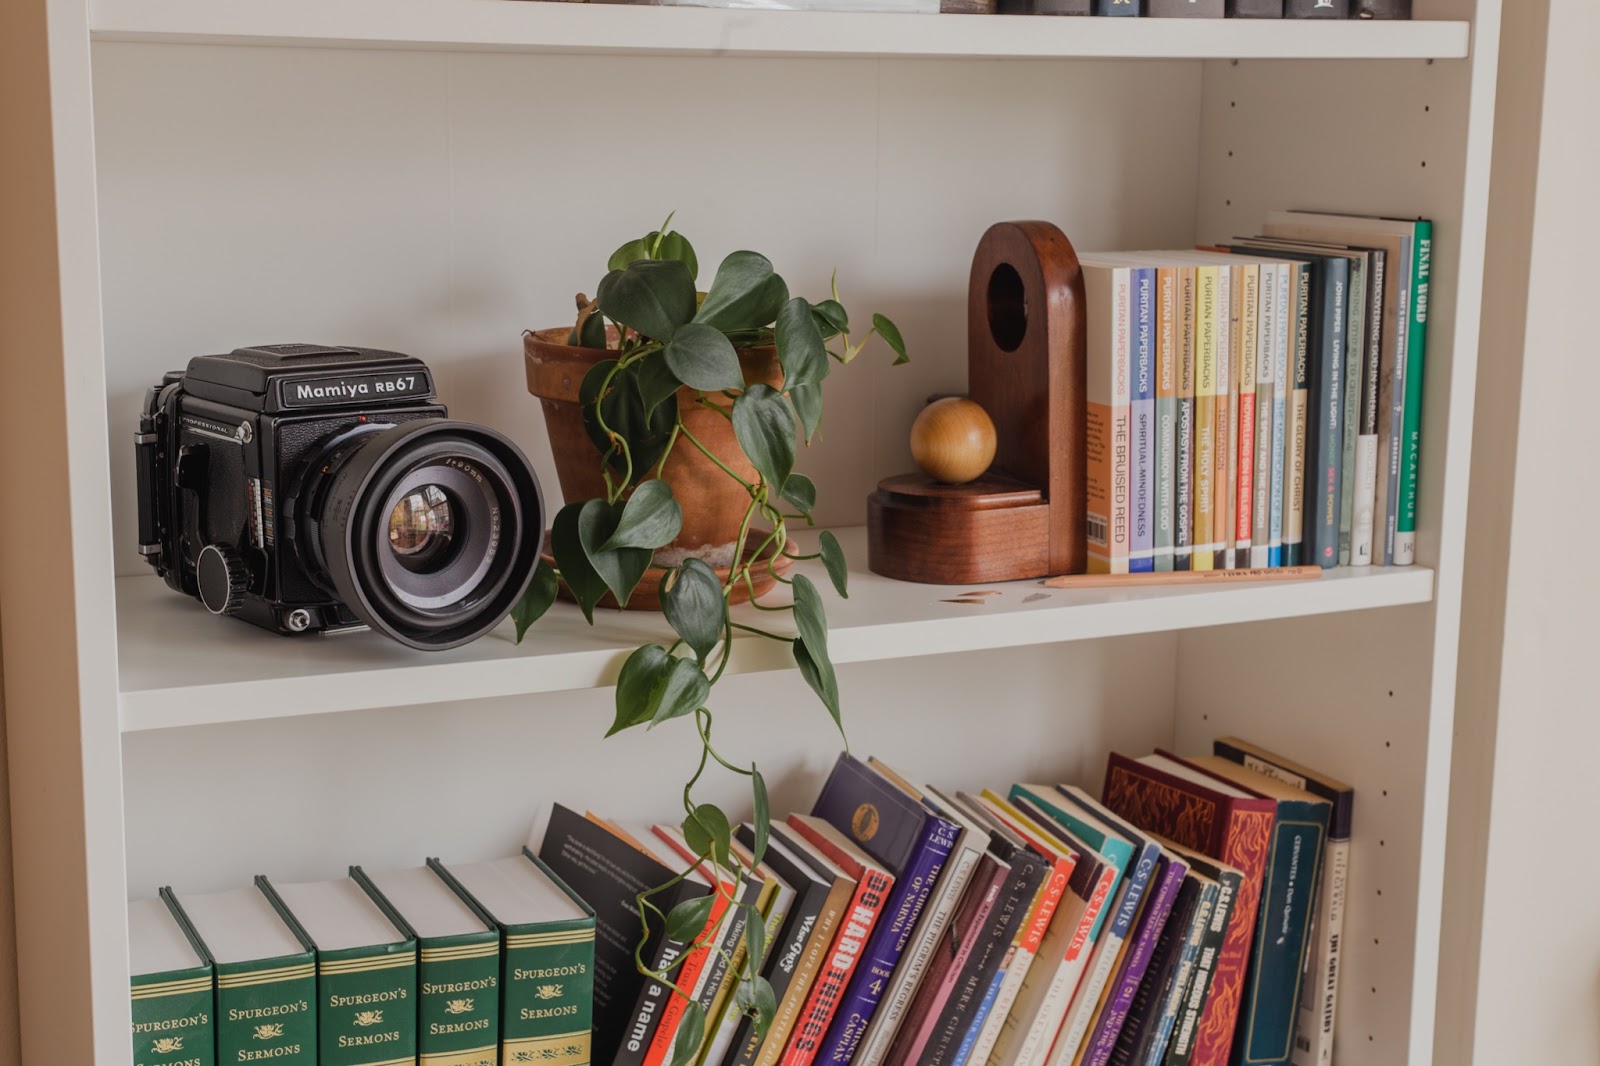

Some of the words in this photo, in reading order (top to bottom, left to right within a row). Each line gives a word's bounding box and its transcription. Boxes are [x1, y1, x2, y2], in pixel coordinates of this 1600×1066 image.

[1418, 238, 1430, 279] FINAL
[1139, 279, 1148, 322] PURITAN
[1184, 278, 1192, 320] PURITAN
[1246, 275, 1254, 316] PURITAN
[1300, 272, 1308, 315] PURITAN
[1372, 261, 1383, 340] REDISCOVERING
[1415, 282, 1428, 323] WORD
[1138, 325, 1147, 392] PAPERBACKS
[1162, 323, 1170, 389] PAPERBACKS
[1182, 324, 1190, 390] PAPERBACKS
[1202, 322, 1211, 388] PAPERBACKS
[1219, 320, 1227, 386] PAPERBACKS
[1244, 320, 1253, 385] PAPERBACKS
[1262, 315, 1271, 377] PAPERBACKS
[1297, 317, 1307, 382] PAPERBACKS
[1370, 344, 1378, 367] GOD
[1331, 370, 1338, 380] IN
[1349, 364, 1356, 375] TO
[1370, 370, 1377, 380] IN
[296, 381, 369, 399] Mamiya
[375, 376, 415, 393] RB67
[1368, 382, 1376, 427] AMERICA
[183, 417, 228, 434] PROFESSIONAL
[1116, 415, 1125, 442] THE
[1180, 401, 1189, 452] APOSTASY
[1241, 396, 1250, 454] INDWELLING
[1160, 414, 1169, 477] COMMUNION
[1273, 422, 1282, 497] MORTIFICATION
[1115, 445, 1125, 502] BRUISED
[1137, 414, 1146, 536] SPIRITUAL-MINDEDNESS
[1180, 454, 1188, 482] FROM
[1240, 475, 1248, 485] IN
[1294, 460, 1301, 473] OF
[1406, 431, 1418, 518] MACARTHUR
[1200, 479, 1208, 513] SPIRIT
[1239, 487, 1248, 537] BELIEVERS
[1256, 490, 1265, 528] CHURCH
[1114, 507, 1124, 543] REED
[1178, 505, 1187, 543] GOSPEL
[928, 833, 954, 848] LEWIS
[938, 827, 946, 836] C.
[1022, 864, 1034, 875] C.
[1288, 834, 1301, 880] CERVANTES
[912, 877, 922, 892] OF
[926, 865, 940, 884] THE
[1014, 880, 1026, 890] S.
[1164, 870, 1175, 884] THE
[860, 875, 888, 908] DO
[986, 885, 998, 902] Lewis
[1118, 884, 1142, 926] LEWIS
[1146, 885, 1168, 929] CHRONICLES
[1284, 887, 1293, 904] Don
[772, 913, 784, 932] The
[822, 910, 836, 931] WHY
[891, 893, 915, 932] NARNIA
[896, 888, 929, 951] CHRONICLES
[933, 912, 946, 929] THE
[982, 904, 988, 913] An
[993, 896, 1018, 936] LEWIS
[1029, 900, 1054, 943] LEWIS
[700, 917, 714, 938] Can
[726, 920, 745, 947] Taking
[832, 906, 874, 970] HARD
[965, 914, 984, 949] Experiment
[1070, 908, 1098, 949] LEWIS
[1329, 934, 1338, 953] THE
[735, 944, 746, 960] THE
[805, 942, 821, 969] LOVE
[910, 932, 936, 979] PILGRIM'S
[1129, 940, 1146, 968] NARNIA
[1200, 947, 1214, 969] THAT
[422, 976, 496, 994] SPURGEON'S
[514, 963, 586, 980] SPURGEON'S
[680, 962, 696, 987] Trust
[713, 969, 722, 980] At
[795, 973, 808, 992] THE
[871, 966, 891, 978] BOOK
[948, 957, 964, 983] Criticism
[1327, 957, 1336, 990] GREAT
[330, 988, 407, 1007] SPURGEON'S
[648, 985, 661, 996] a
[706, 982, 718, 996] His
[868, 979, 881, 996] 4
[890, 981, 913, 1022] REGRESS
[957, 976, 978, 1011] MERE
[985, 982, 996, 1001] THE
[1188, 970, 1208, 1009] HIDEOUS
[229, 1001, 308, 1021] SPURGEON'S
[430, 1019, 489, 1034] SERMONS
[520, 1005, 577, 1020] SERMONS
[628, 1001, 656, 1051] name
[656, 1004, 678, 1048] Gospels?
[774, 994, 796, 1040] APOSTLE
[795, 970, 846, 1052] THINGS
[970, 1006, 986, 1032] FOUR
[1323, 994, 1332, 1032] GATSBY
[338, 1031, 399, 1047] SERMONS
[833, 1013, 860, 1061] CASPIAN
[843, 1019, 868, 1061] PRINCE
[1175, 1009, 1196, 1055] STRENGTH
[238, 1044, 301, 1062] SERMONS
